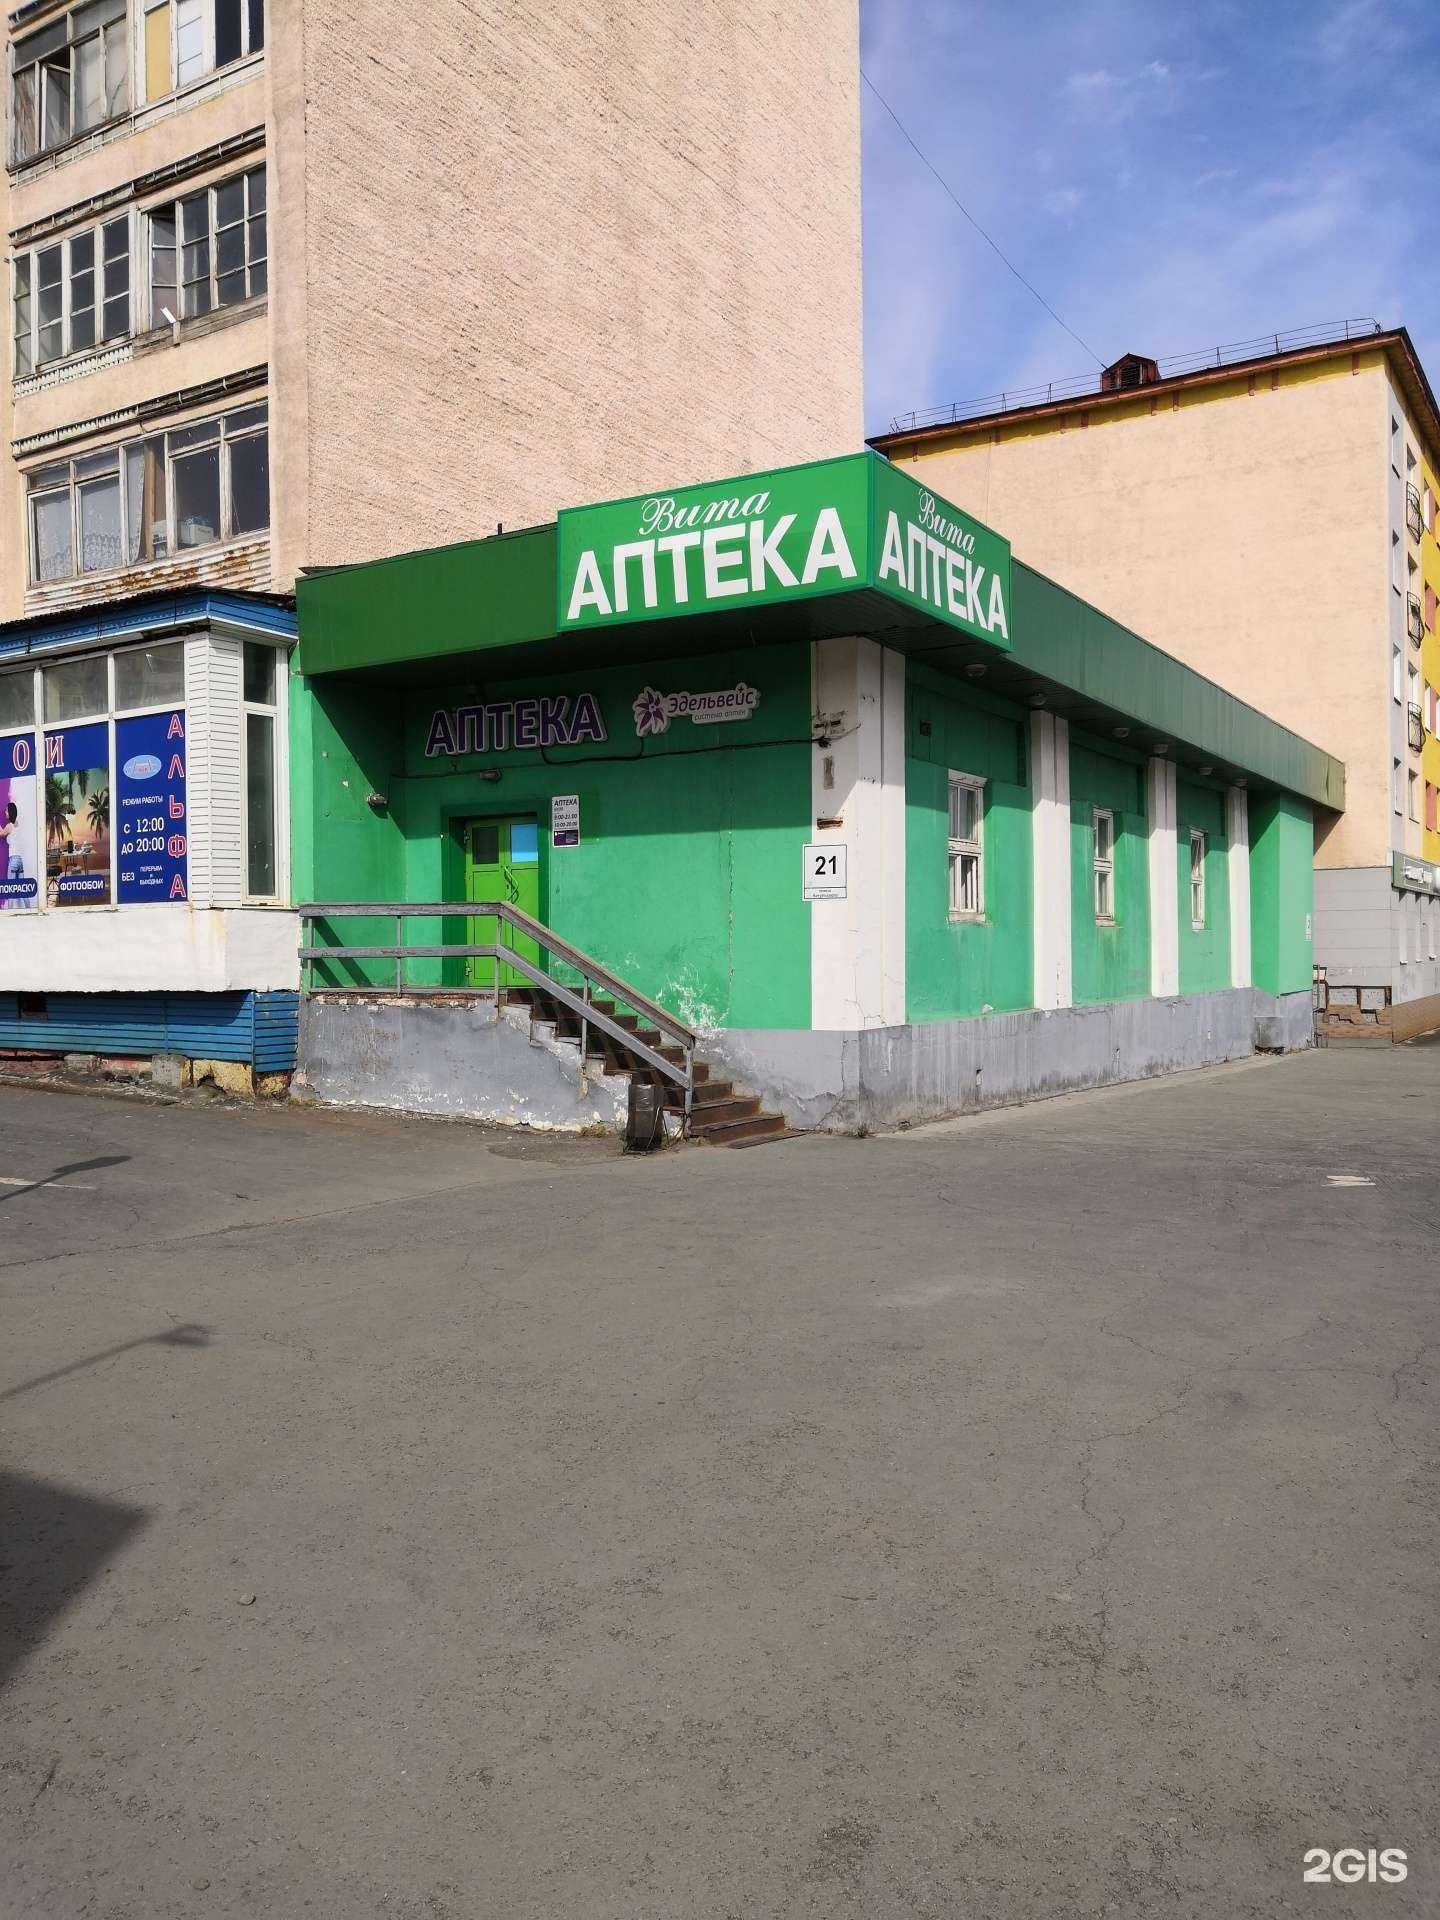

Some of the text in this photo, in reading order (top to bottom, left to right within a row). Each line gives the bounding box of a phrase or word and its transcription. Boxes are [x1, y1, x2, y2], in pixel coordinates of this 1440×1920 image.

[638, 490, 772, 536] Вита
[916, 487, 977, 556] Вита
[566, 507, 858, 620] АПТЕКА
[878, 510, 1009, 640] АПТЕКА
[668, 687, 754, 713] Эдельвейс
[424, 694, 605, 757] АПТЕКА
[122, 795, 163, 807] РЕЖИМ РАБОТЫ
[136, 816, 165, 833] 12:00
[121, 836, 165, 856] ДО 20:00
[121, 871, 135, 882] БЕЗ
[815, 855, 837, 876] 21
[60, 880, 104, 891] ФОТООБОИ
